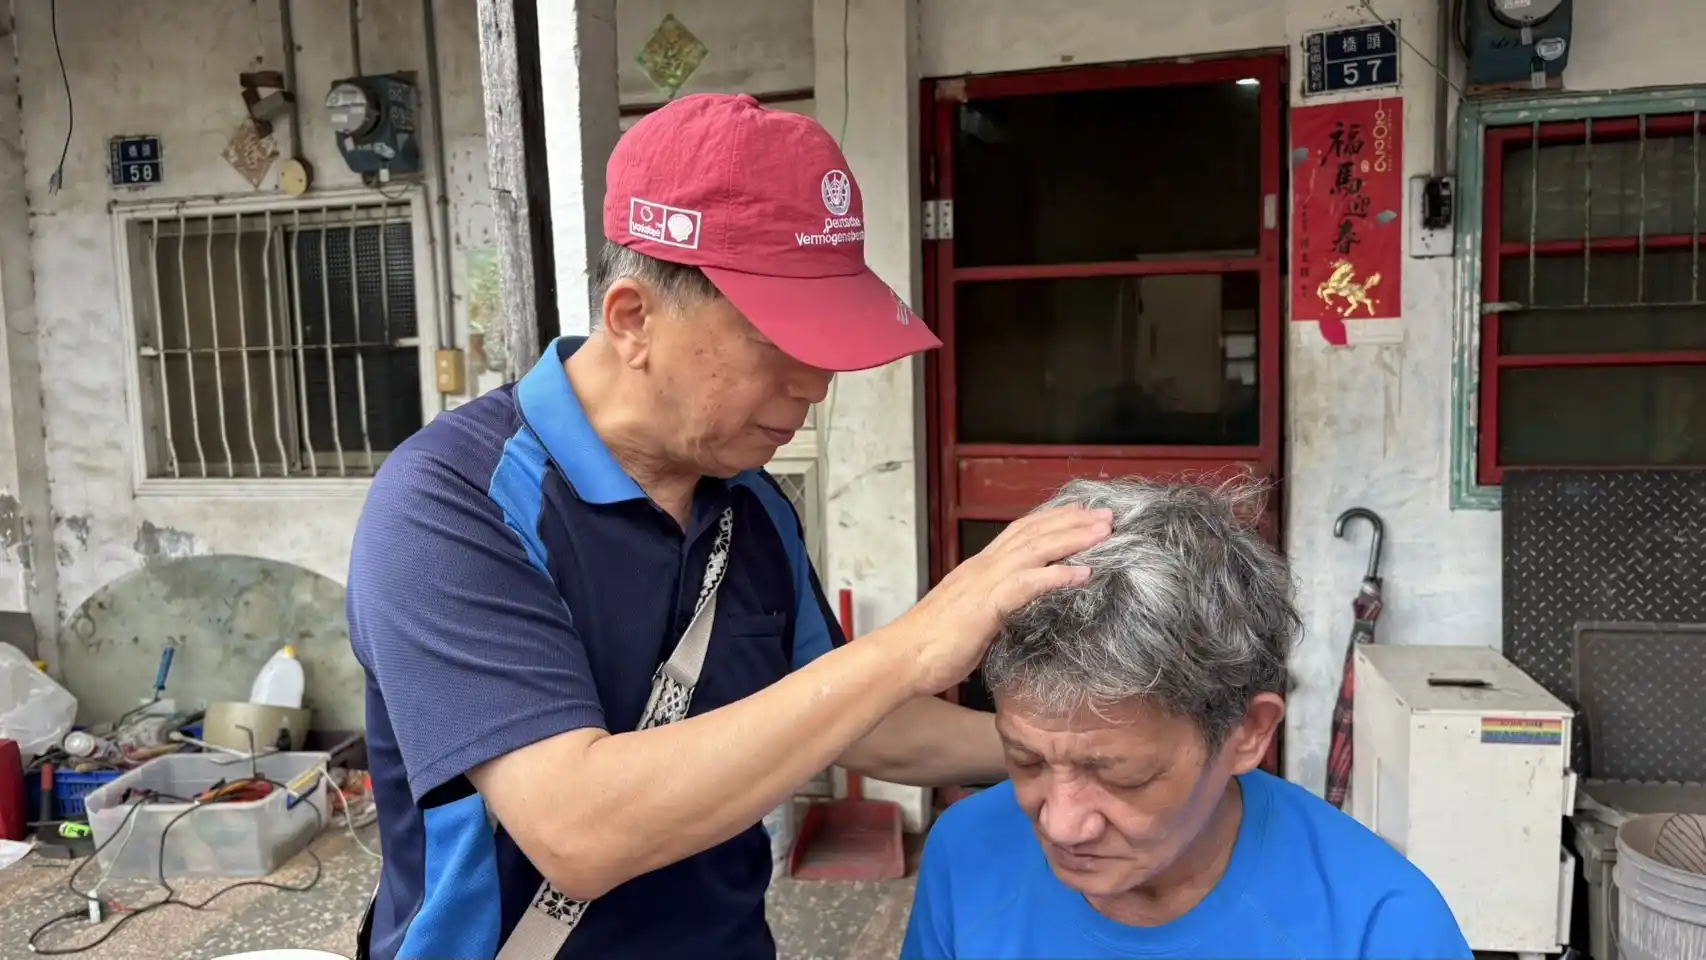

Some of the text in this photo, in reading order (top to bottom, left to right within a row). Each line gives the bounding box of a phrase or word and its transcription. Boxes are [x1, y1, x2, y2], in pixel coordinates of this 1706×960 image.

[1343, 59, 1382, 85] 57
[1373, 109, 1388, 172] 2026
[129, 164, 152, 182] 58
[1320, 121, 1371, 255] 福馬迎春
